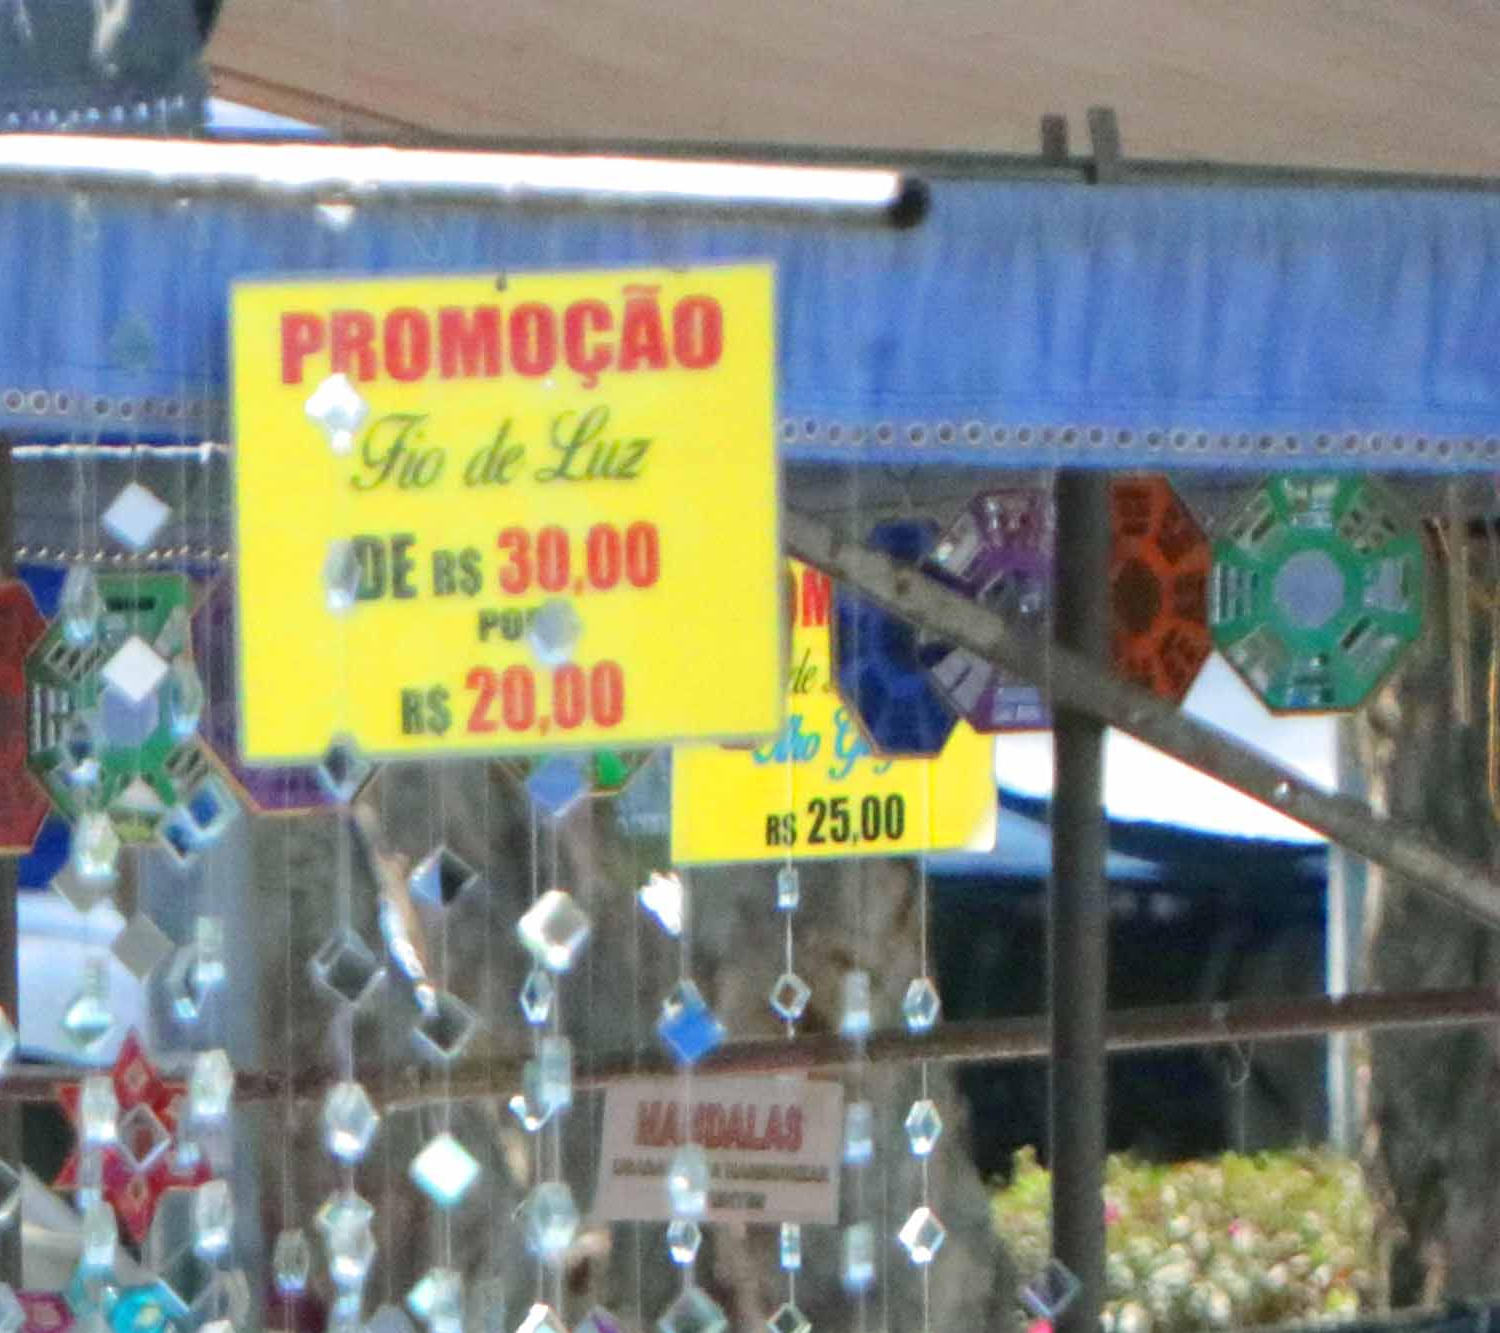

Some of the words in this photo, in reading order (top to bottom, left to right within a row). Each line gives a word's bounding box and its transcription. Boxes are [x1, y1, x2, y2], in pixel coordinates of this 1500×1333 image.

[280, 283, 723, 389] PROMOÇÃO
[350, 411, 446, 491] Fio
[464, 417, 525, 487] de
[535, 405, 652, 484] Luz
[349, 533, 417, 601] DE
[433, 547, 484, 597] R$
[496, 519, 661, 596] 30,00
[478, 606, 540, 642] PO
[401, 685, 451, 735] R$
[465, 659, 625, 734] 20,00
[766, 813, 797, 847] R$
[808, 793, 905, 845] 25,00
